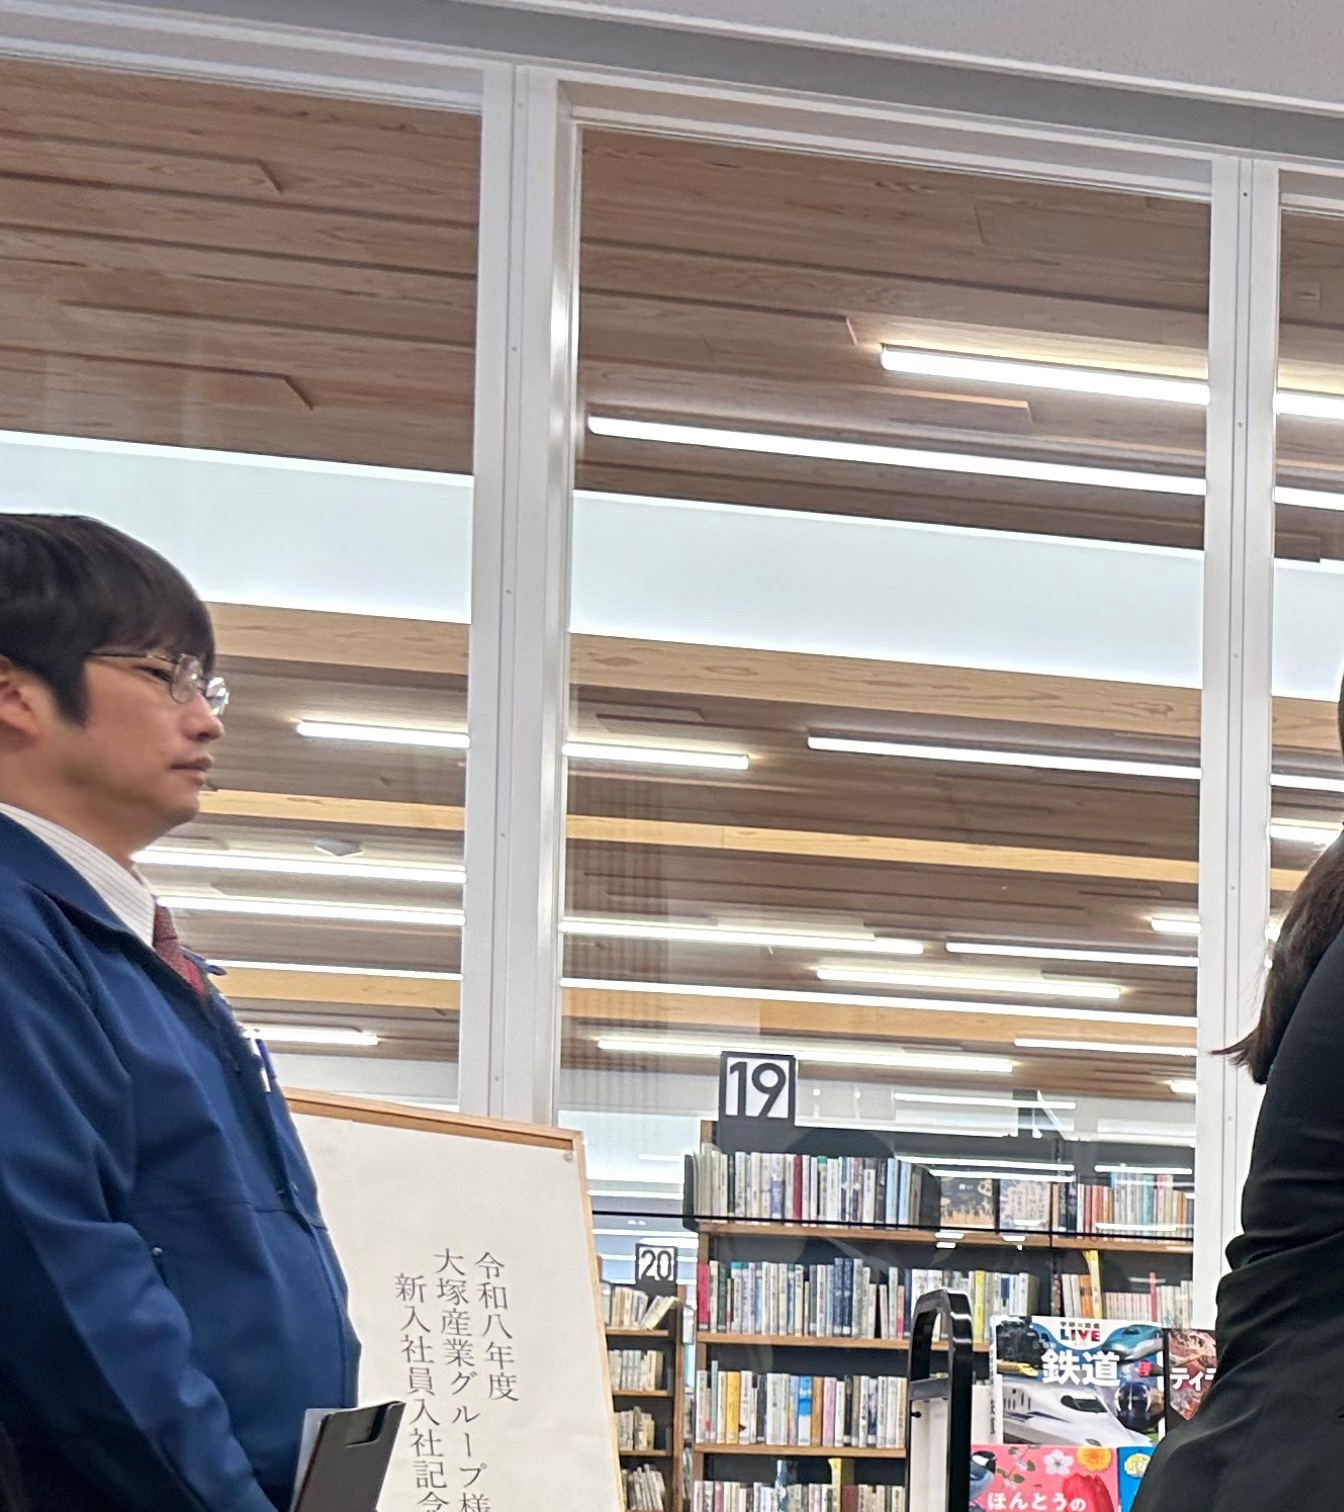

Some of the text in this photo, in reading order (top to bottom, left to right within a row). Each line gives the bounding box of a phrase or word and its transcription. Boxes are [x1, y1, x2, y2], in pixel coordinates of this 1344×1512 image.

[730, 1061, 786, 1118] 19
[641, 1249, 672, 1281] 20
[475, 1251, 519, 1401] 令和八年度
[1060, 1329, 1100, 1342] LIVE
[1041, 1350, 1120, 1386] 鉄道
[987, 1491, 1086, 1512] ほんとうの
